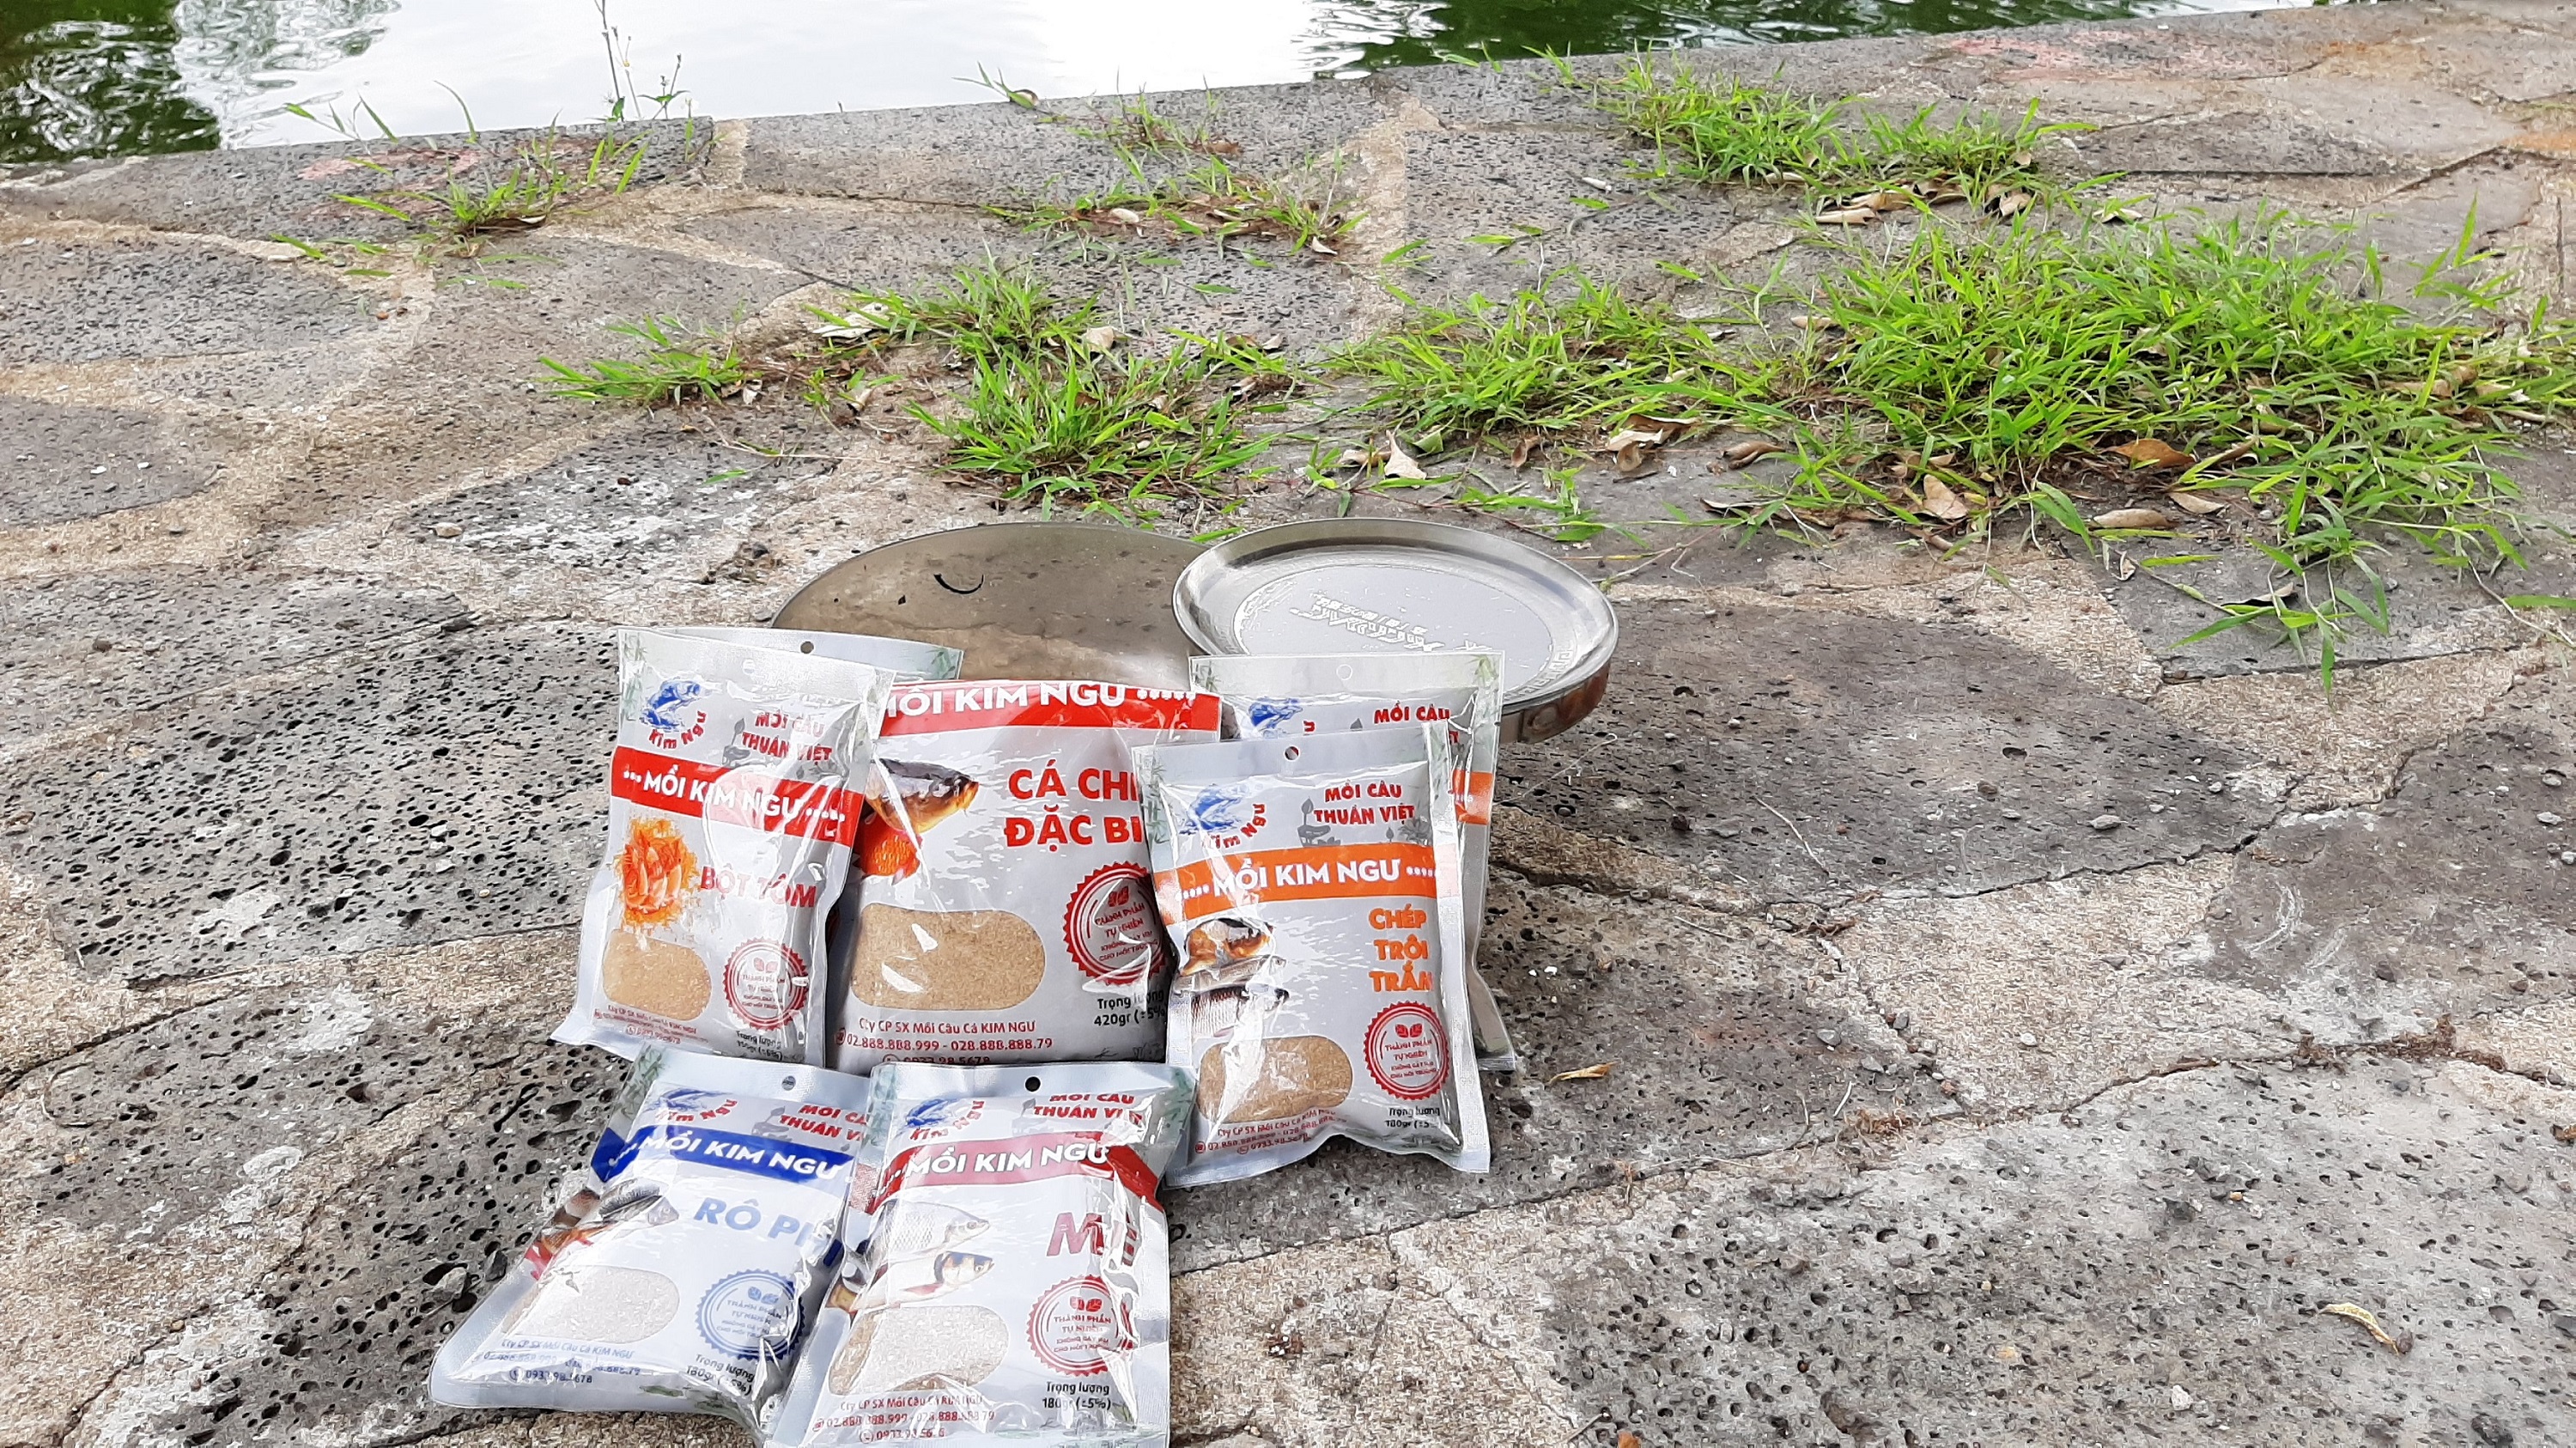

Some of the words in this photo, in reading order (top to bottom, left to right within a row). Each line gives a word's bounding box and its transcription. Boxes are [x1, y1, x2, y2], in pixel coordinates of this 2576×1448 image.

[955, 685, 1029, 713] KIM
[648, 728, 677, 750] Kim
[1008, 759, 1066, 800] CÁ
[690, 781, 734, 809] KIM
[1379, 801, 1415, 824] VIỆT
[1003, 803, 1094, 852] ĐẶC
[1275, 861, 1330, 886] KIM
[1368, 903, 1427, 930] CHÉP
[1373, 933, 1429, 960] TRÔI
[1097, 998, 1132, 1011] Trọng
[878, 1019, 892, 1031] CP
[896, 1020, 910, 1032] SX
[963, 1022, 978, 1034] Cá
[981, 1022, 1005, 1033] KIM
[1093, 1013, 1132, 1027] 420gr
[704, 1139, 766, 1165] KIM
[906, 1145, 967, 1177] MỒI
[973, 1151, 1032, 1173] KIM
[693, 1196, 762, 1231] RÔ
[1046, 1381, 1077, 1396] Trọng
[1078, 1381, 1110, 1396] lượng
[872, 1398, 884, 1408] SX
